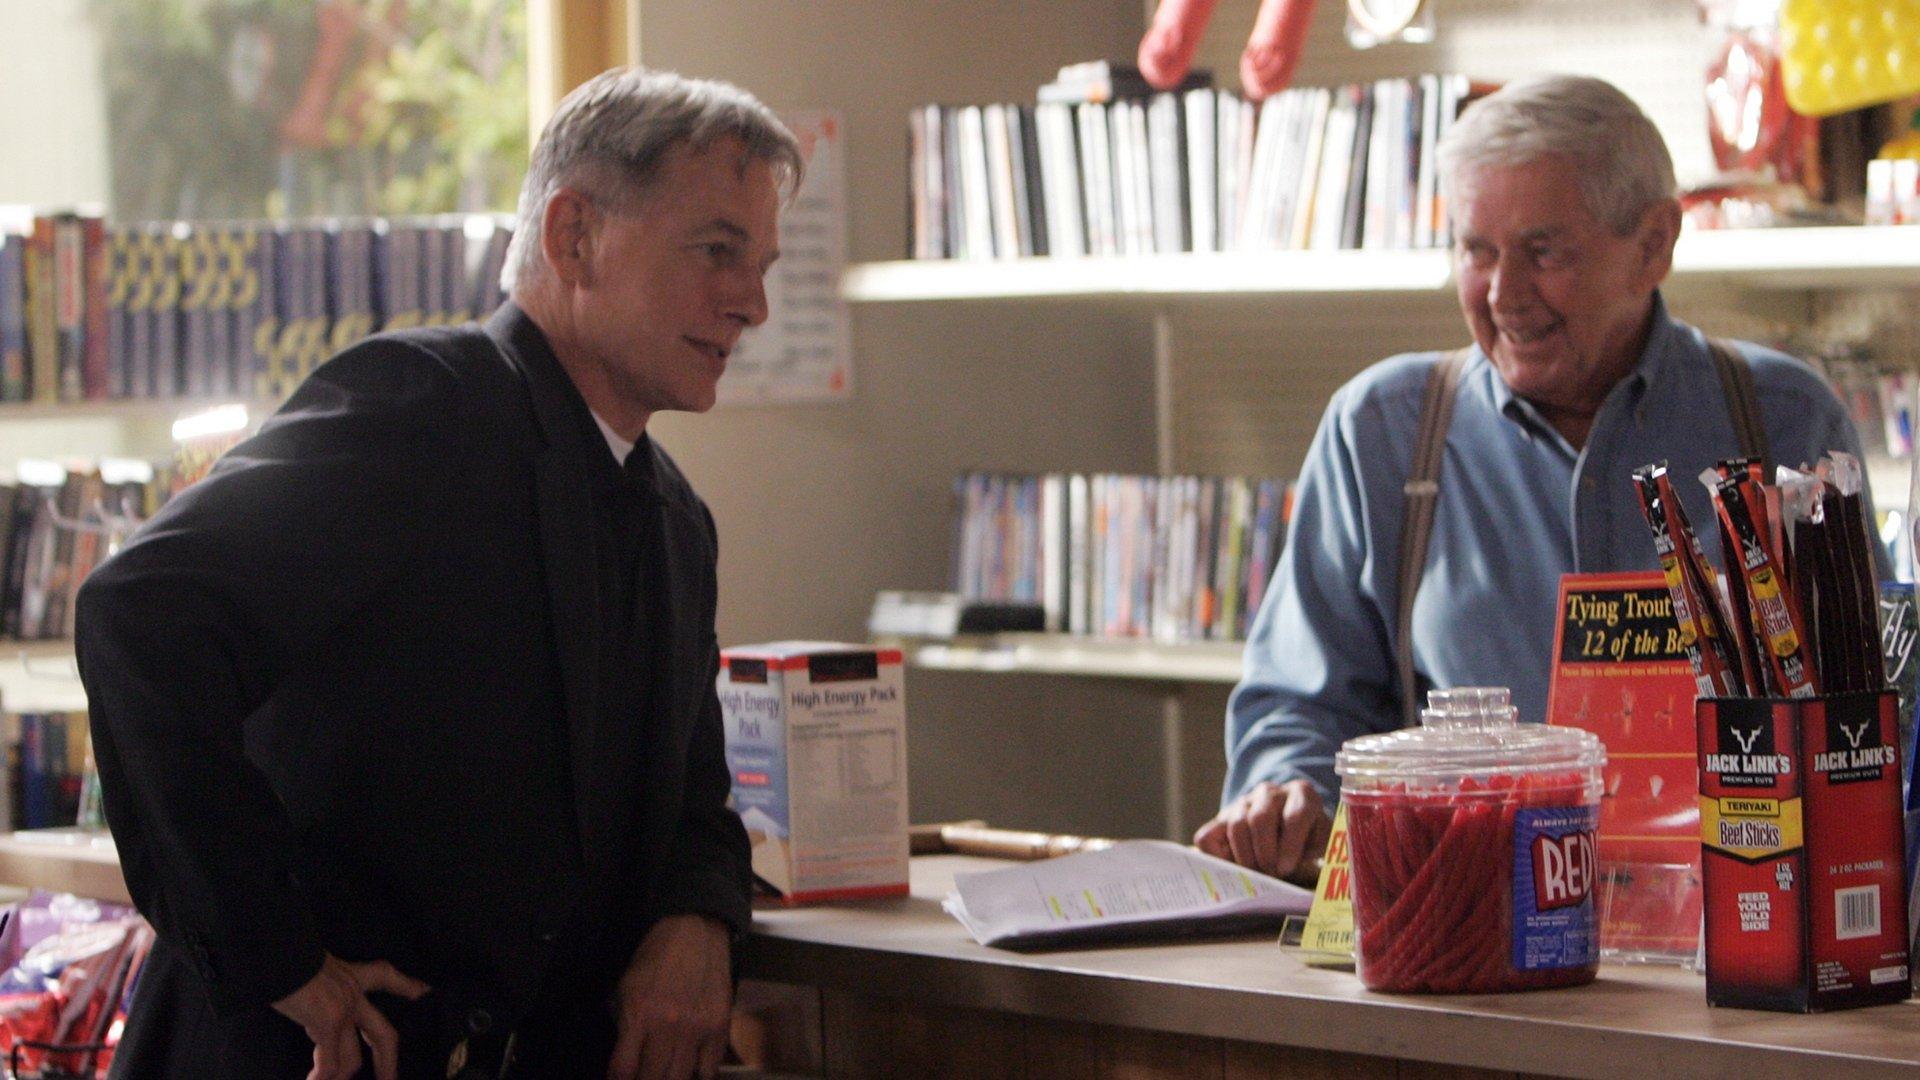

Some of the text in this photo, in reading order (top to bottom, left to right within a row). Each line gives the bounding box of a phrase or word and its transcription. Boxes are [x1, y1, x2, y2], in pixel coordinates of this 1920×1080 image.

[1567, 592, 1672, 627] Tying Trout
[1581, 630, 1606, 656] 12
[1610, 628, 1632, 662] of
[1634, 629, 1660, 656] the
[744, 691, 780, 718] Energy
[791, 686, 896, 709] High Energy Pack
[739, 718, 762, 738] Pack
[1706, 752, 1791, 775] JACK LINK'S
[1814, 745, 1895, 772] JACK LINK'S
[1726, 801, 1772, 813] TERIYAKI
[1719, 820, 1780, 848] Beef Sticks
[1327, 830, 1349, 864] FI
[1738, 892, 1768, 902] FEED
[1738, 901, 1771, 912] YOUR
[1740, 911, 1770, 922] WILD
[1741, 920, 1770, 932] SIDE
